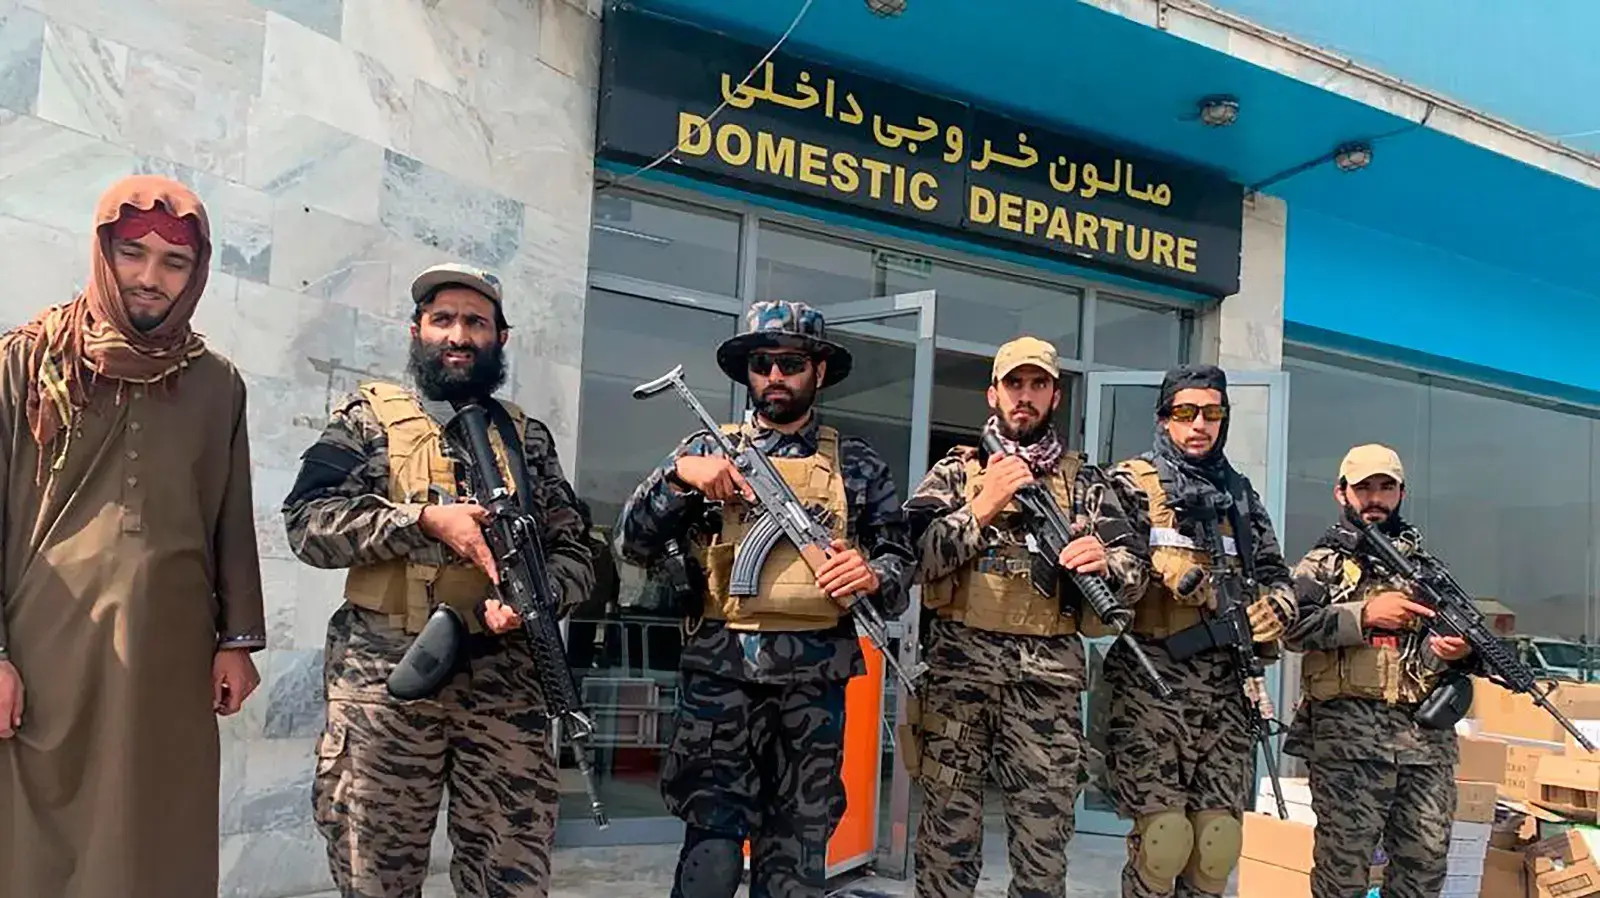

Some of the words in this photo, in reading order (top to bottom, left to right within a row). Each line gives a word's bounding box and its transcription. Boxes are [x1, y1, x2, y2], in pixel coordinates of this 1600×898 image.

[721, 61, 864, 125] داخلی
[678, 112, 939, 211] DOMESTIC
[969, 186, 1198, 273] DEPARTURE
[1049, 156, 1171, 207] صالون
